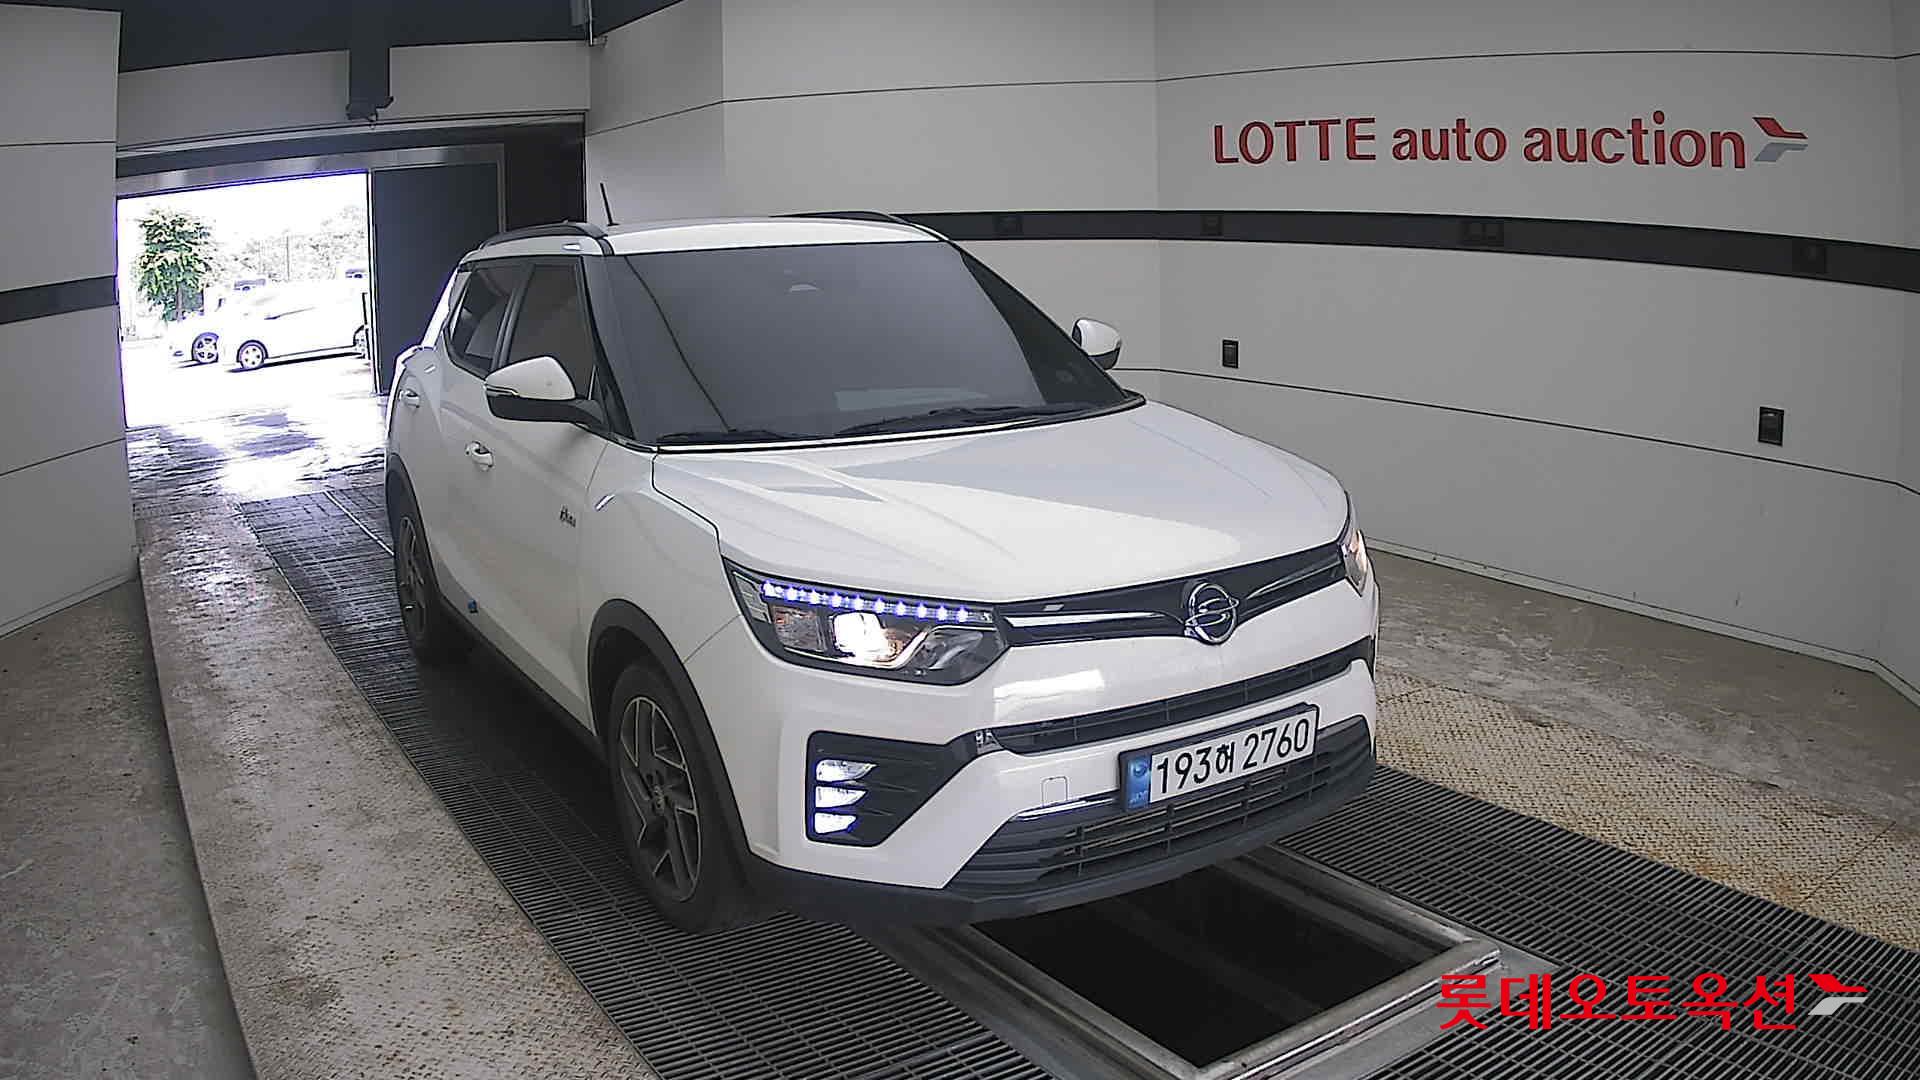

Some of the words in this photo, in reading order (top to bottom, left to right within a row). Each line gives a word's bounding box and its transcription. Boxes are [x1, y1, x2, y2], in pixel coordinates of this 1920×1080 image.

[1213, 117, 1376, 164] LOTTE
[1391, 118, 1507, 162] auto
[1523, 110, 1746, 169] auction
[1156, 741, 1236, 794] 193허
[1242, 718, 1310, 770] 2760
